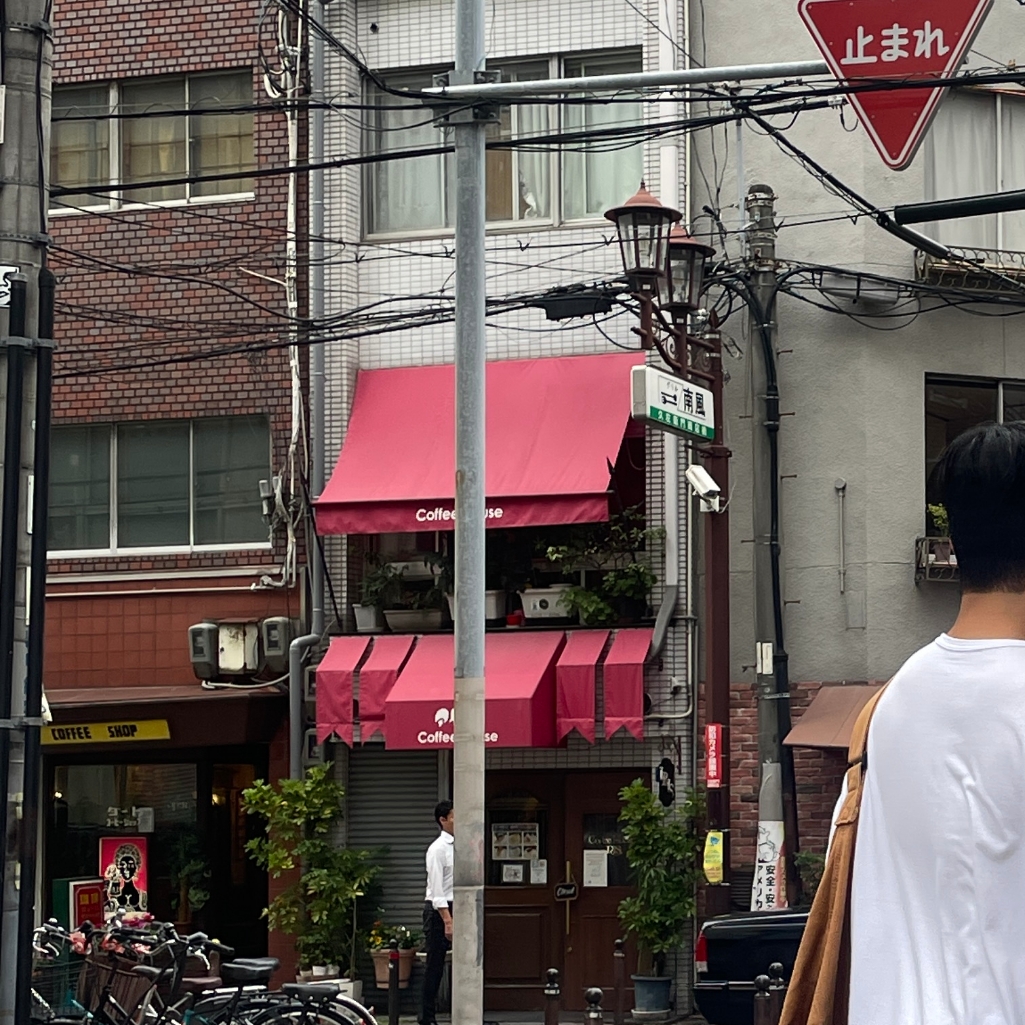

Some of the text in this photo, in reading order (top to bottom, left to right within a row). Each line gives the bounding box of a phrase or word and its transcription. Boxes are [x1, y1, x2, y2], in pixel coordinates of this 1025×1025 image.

[840, 20, 950, 65] 止まれ
[683, 388, 706, 417] 南風
[415, 507, 456, 521] Coffee
[51, 724, 138, 741] COFFEE SHOP
[417, 730, 455, 744] Coffee
